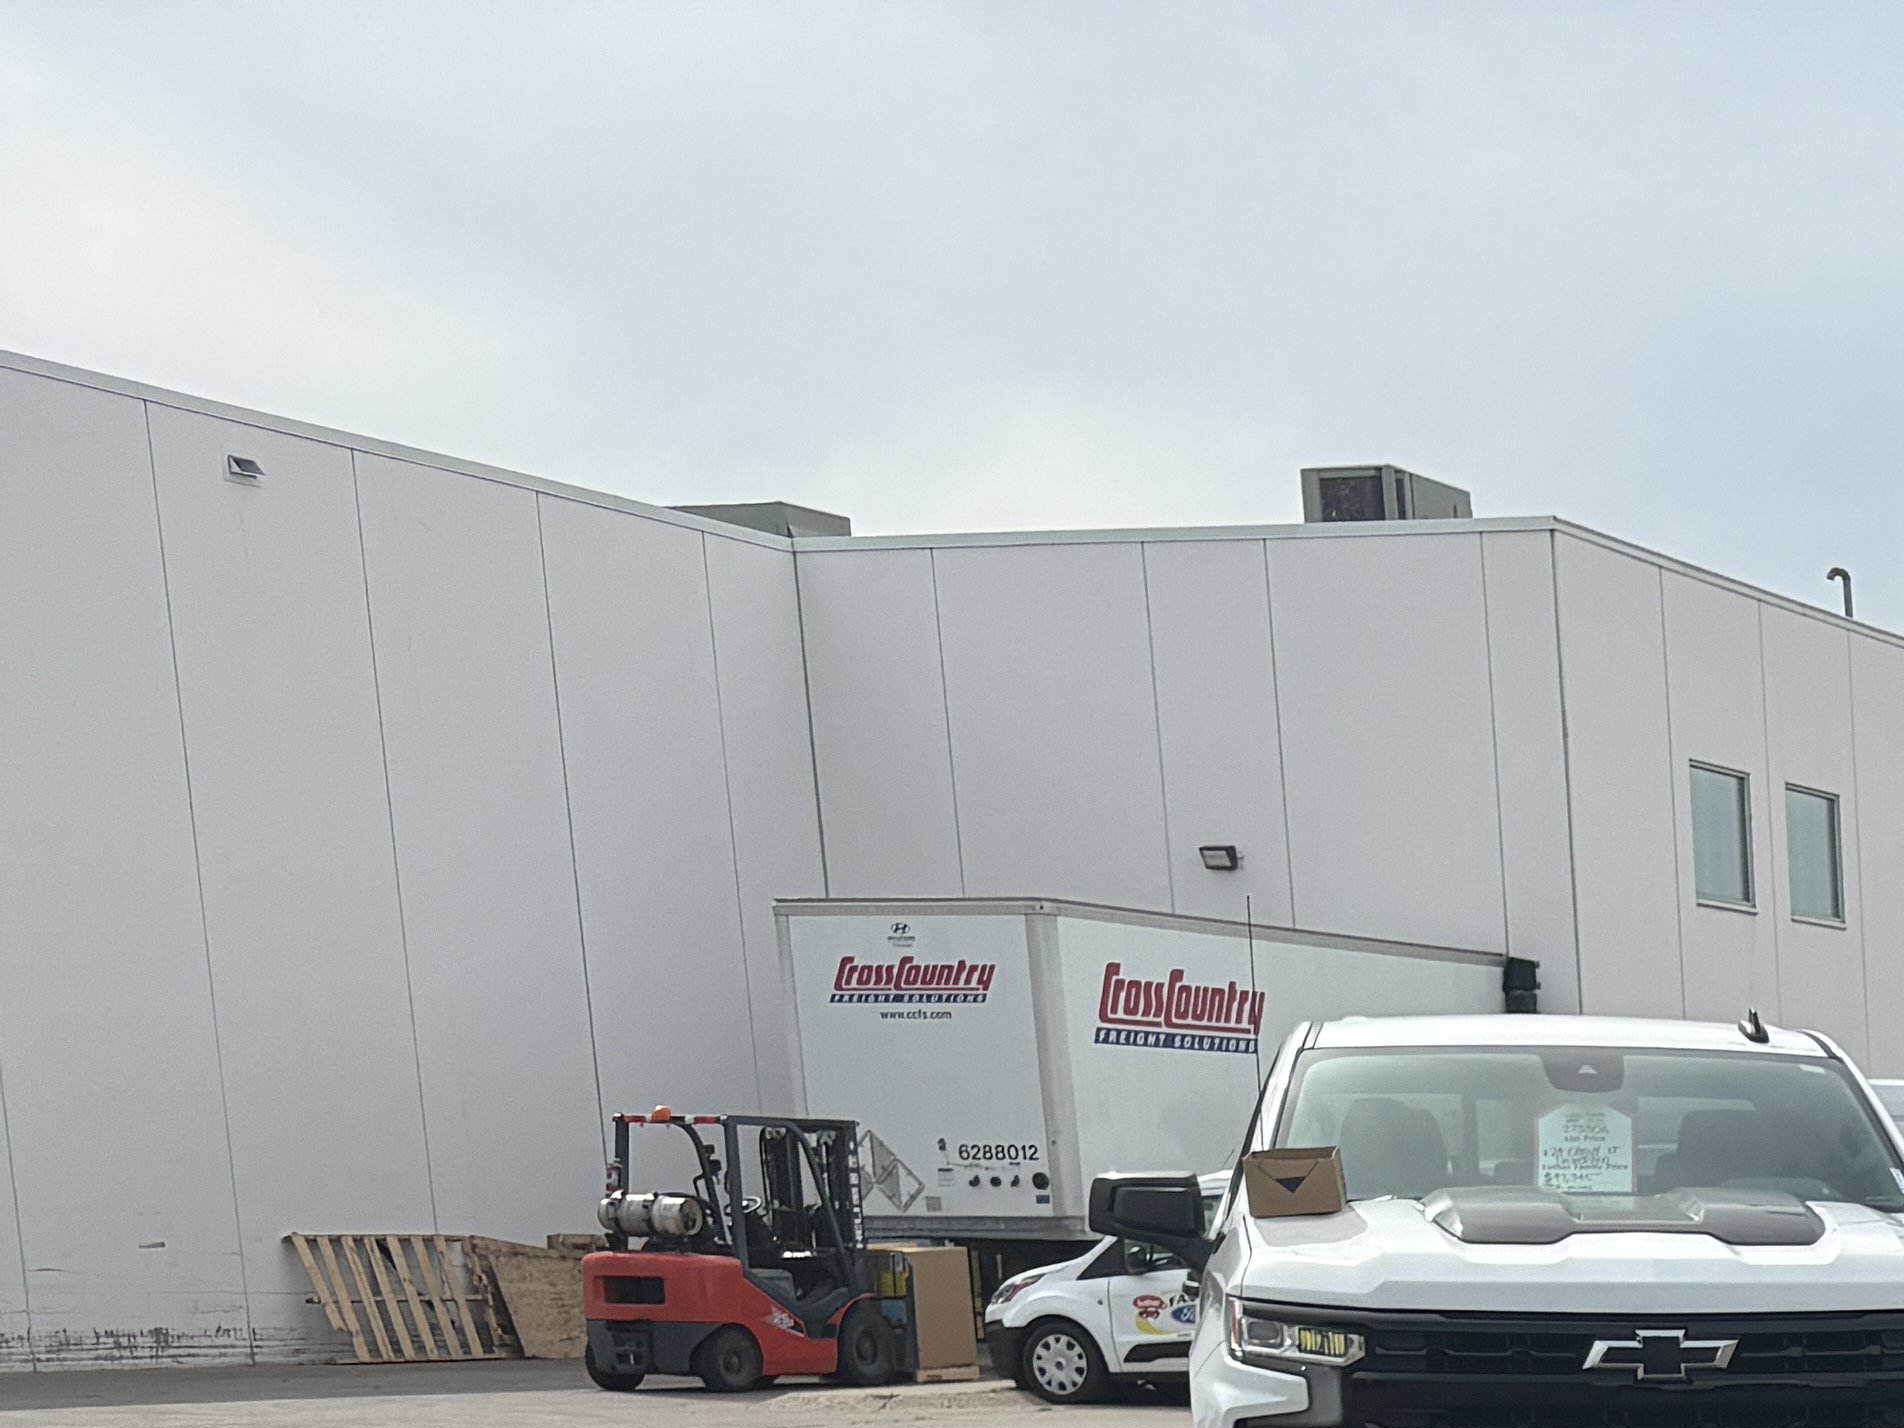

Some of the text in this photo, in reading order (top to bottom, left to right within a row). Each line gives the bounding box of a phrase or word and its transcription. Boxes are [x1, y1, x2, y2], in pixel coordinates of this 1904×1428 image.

[833, 955, 997, 992] CrossCountry
[832, 993, 893, 1004] FREIGHT
[1099, 961, 1266, 1037] CrossCountry
[1099, 1028, 1255, 1053] FREIGHT SOLUTIONS
[958, 1144, 1040, 1161] 6288012
